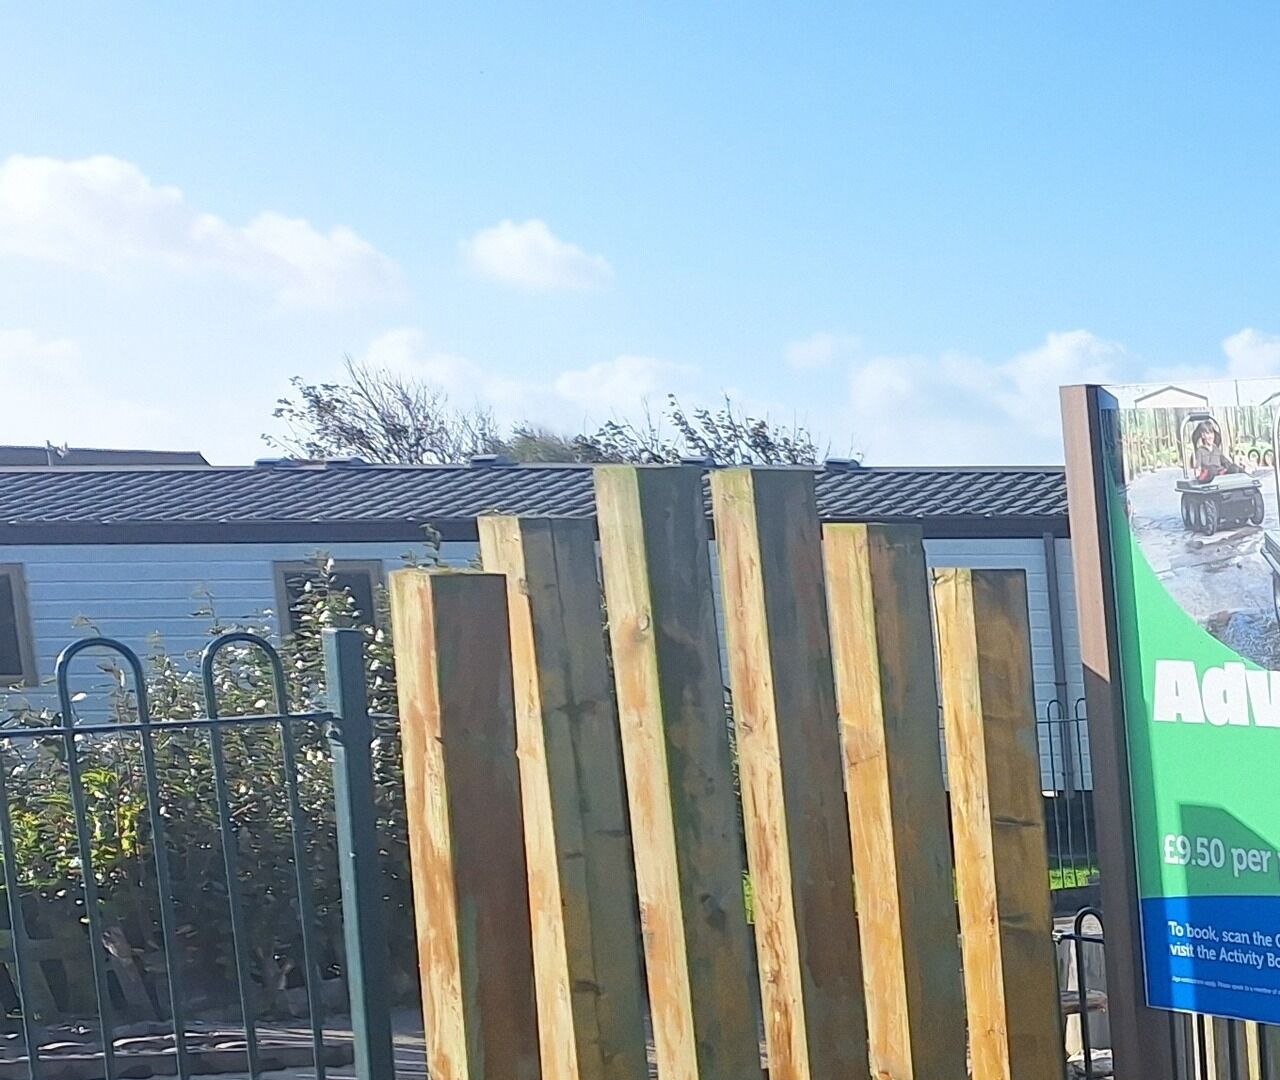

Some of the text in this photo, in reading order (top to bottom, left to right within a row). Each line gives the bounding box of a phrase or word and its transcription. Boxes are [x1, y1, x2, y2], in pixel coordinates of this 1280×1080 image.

[1164, 834, 1226, 868] £9.50
[1231, 847, 1271, 877] per
[1168, 920, 1184, 937] To
[1185, 922, 1219, 942] book,
[1222, 930, 1250, 945] scan
[1252, 931, 1273, 947] the
[1169, 942, 1194, 958] visit
[1197, 944, 1217, 960] the
[1219, 946, 1264, 970] Activity
